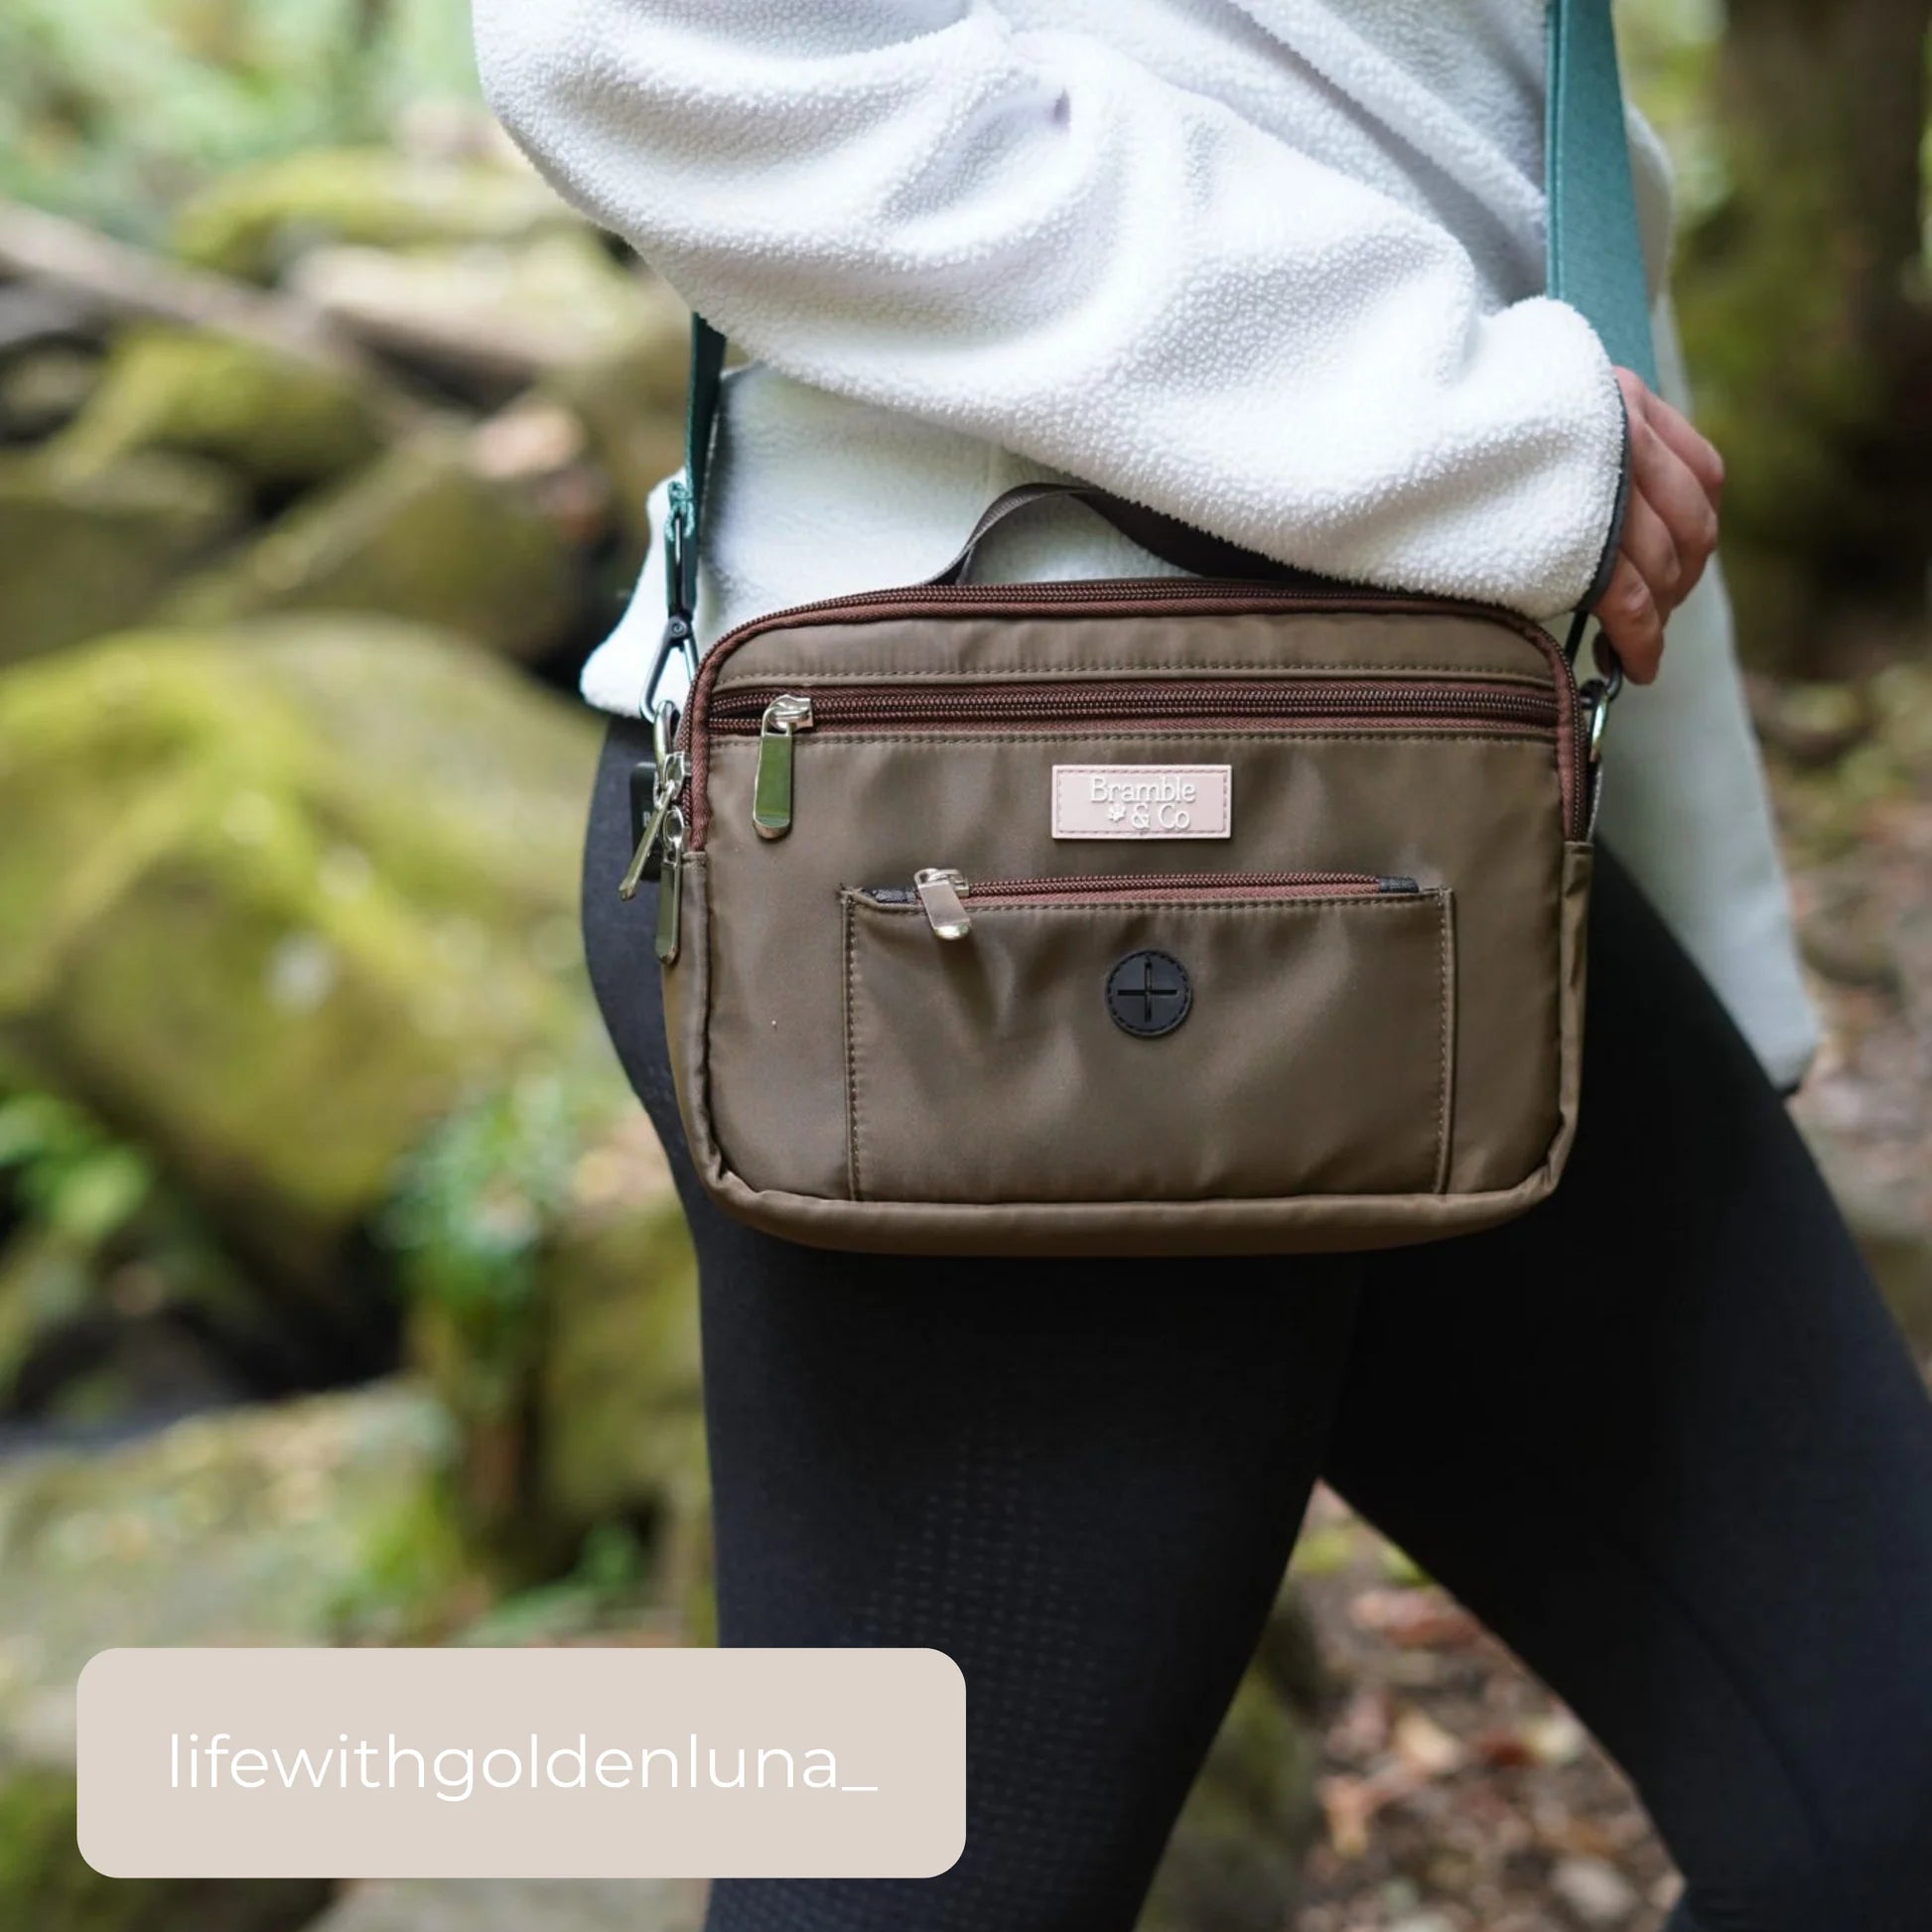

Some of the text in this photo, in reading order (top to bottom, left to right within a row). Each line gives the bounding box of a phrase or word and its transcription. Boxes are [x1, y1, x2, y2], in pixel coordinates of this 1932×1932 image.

[1091, 775, 1196, 803] Bramble
[1132, 802, 1190, 830] & Co
